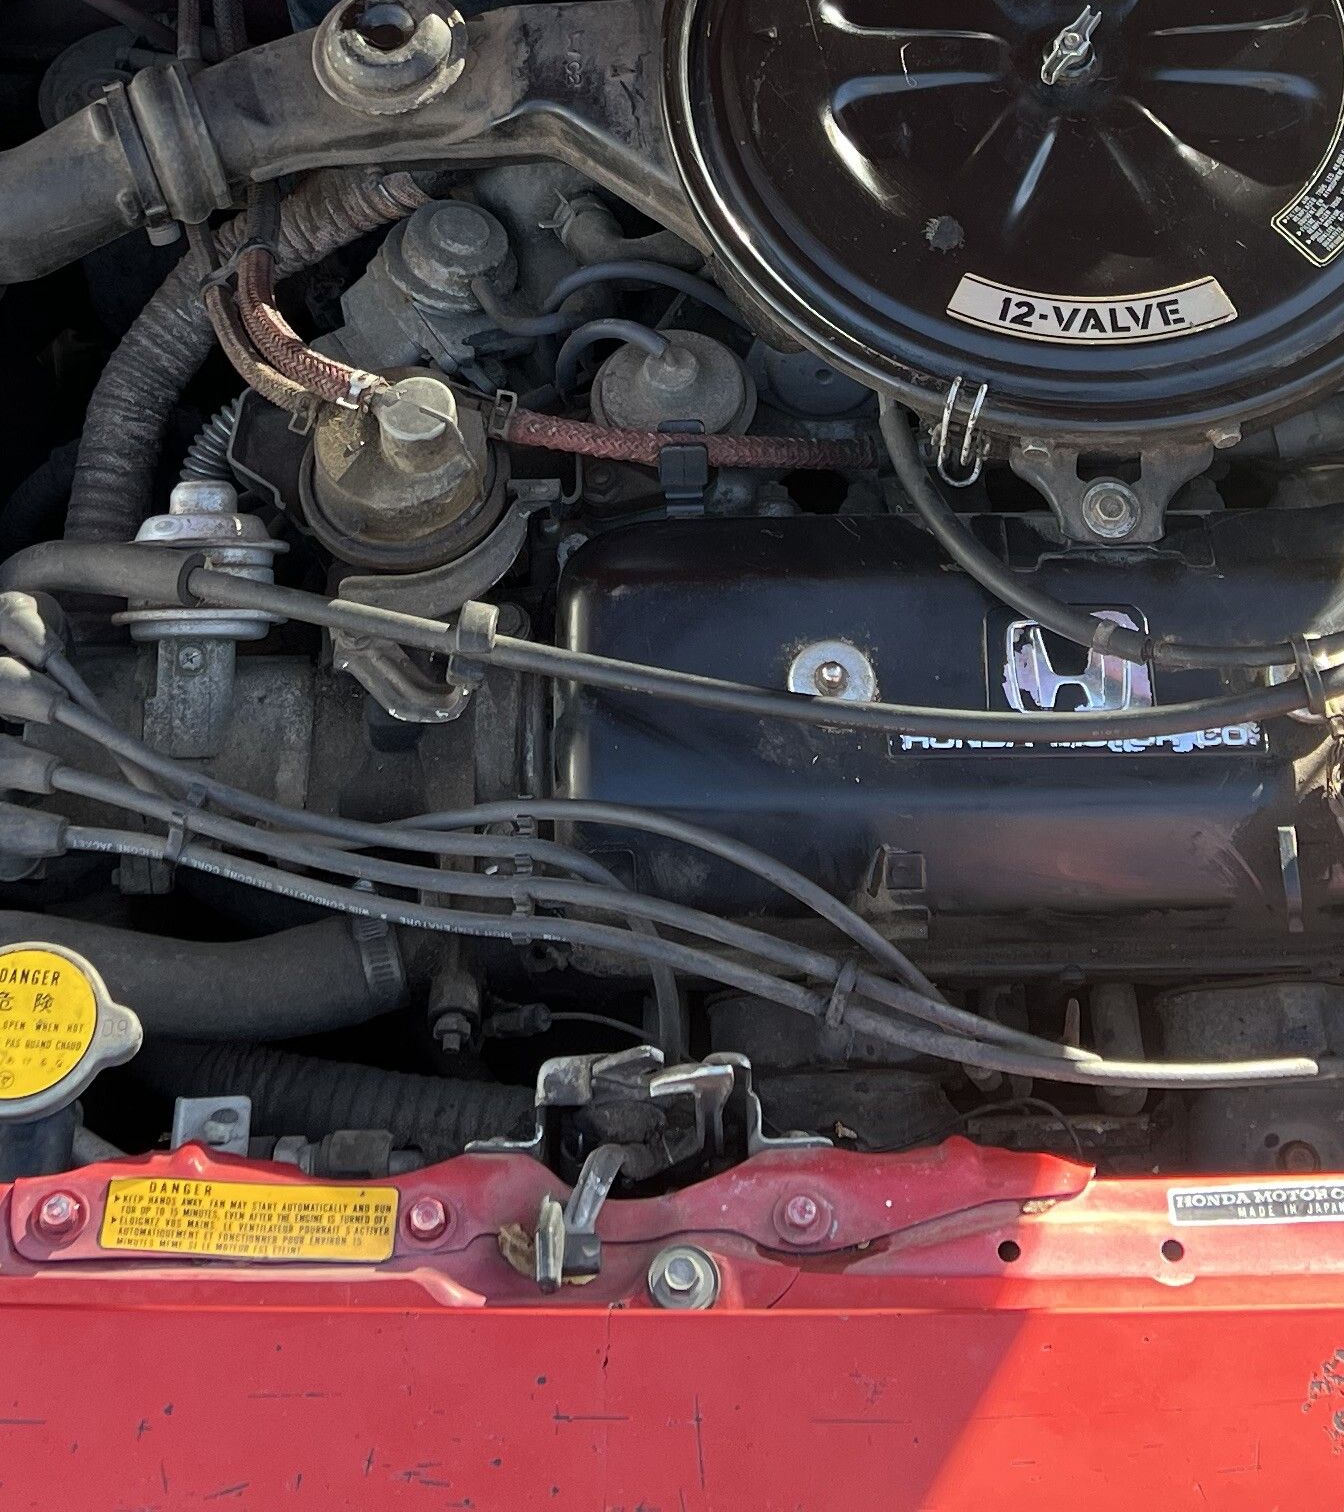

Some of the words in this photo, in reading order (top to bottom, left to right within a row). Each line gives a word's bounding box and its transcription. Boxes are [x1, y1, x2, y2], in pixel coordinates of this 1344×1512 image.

[999, 297, 1185, 335] 12-VALVE
[0, 967, 61, 986] DANGER
[2, 1020, 26, 1030] OPEN
[35, 1020, 59, 1032] WHEN
[67, 1023, 84, 1032] HOT
[149, 1181, 212, 1196] DANGER
[1176, 1191, 1251, 1208] HONDA
[1254, 1188, 1328, 1204] MOTOR
[123, 1194, 144, 1204] KEEP
[148, 1196, 176, 1206] HANDS
[210, 1200, 225, 1208] FAN
[230, 1200, 247, 1209] MAY
[253, 1201, 277, 1211] START
[282, 1203, 347, 1213] AUTOMATICALLY
[353, 1204, 370, 1213] AND
[374, 1205, 392, 1214] RUN
[1238, 1205, 1275, 1218] MADE
[1284, 1204, 1297, 1216] IN
[121, 1205, 136, 1215] FOR
[140, 1207, 151, 1215] UP
[224, 1210, 244, 1219] EVEN
[249, 1212, 273, 1222] AFTER
[277, 1213, 290, 1222] THE
[341, 1215, 370, 1224] TURNED
